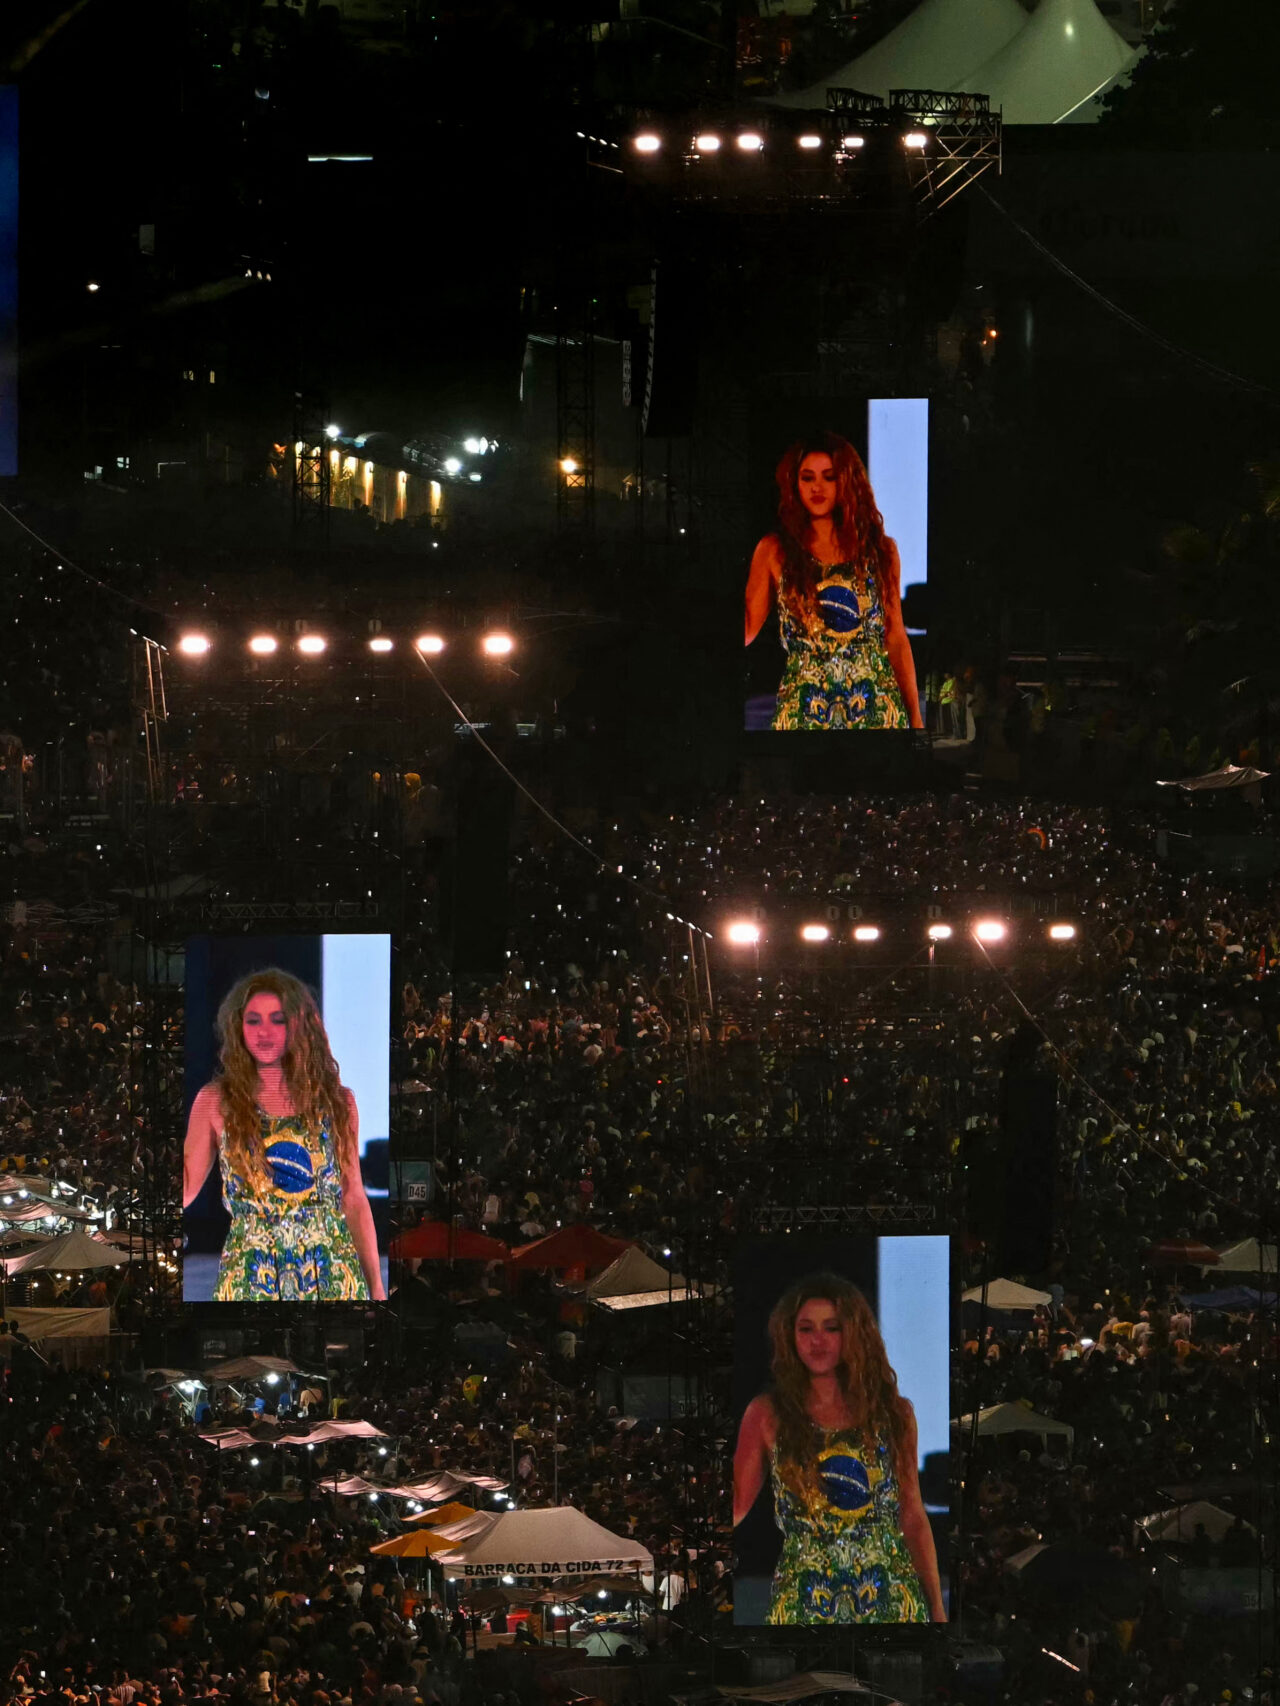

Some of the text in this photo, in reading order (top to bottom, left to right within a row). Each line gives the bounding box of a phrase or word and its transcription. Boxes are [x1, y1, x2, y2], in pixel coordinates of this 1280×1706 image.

[409, 1186, 426, 1199] D45
[463, 1560, 623, 1576] BARRACA DA CIDA 72
